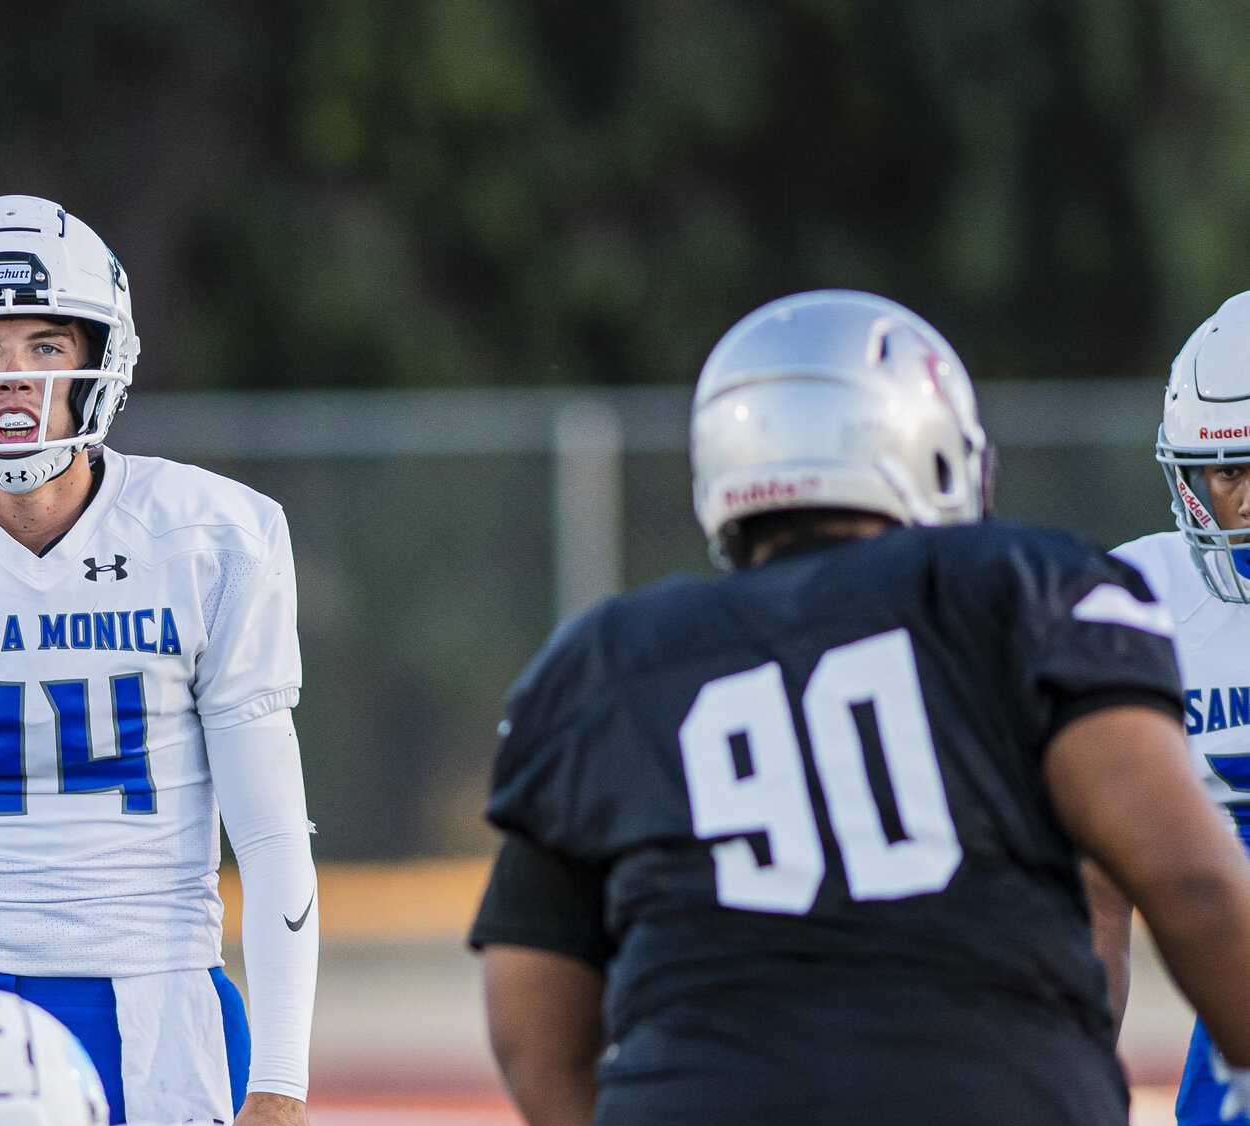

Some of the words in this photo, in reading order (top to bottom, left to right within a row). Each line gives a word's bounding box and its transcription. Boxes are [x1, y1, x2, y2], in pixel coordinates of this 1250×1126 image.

[4, 420, 29, 428] SHOCK
[1199, 425, 1250, 440] Riddel
[37, 606, 182, 656] MONICA
[677, 626, 965, 917] 90
